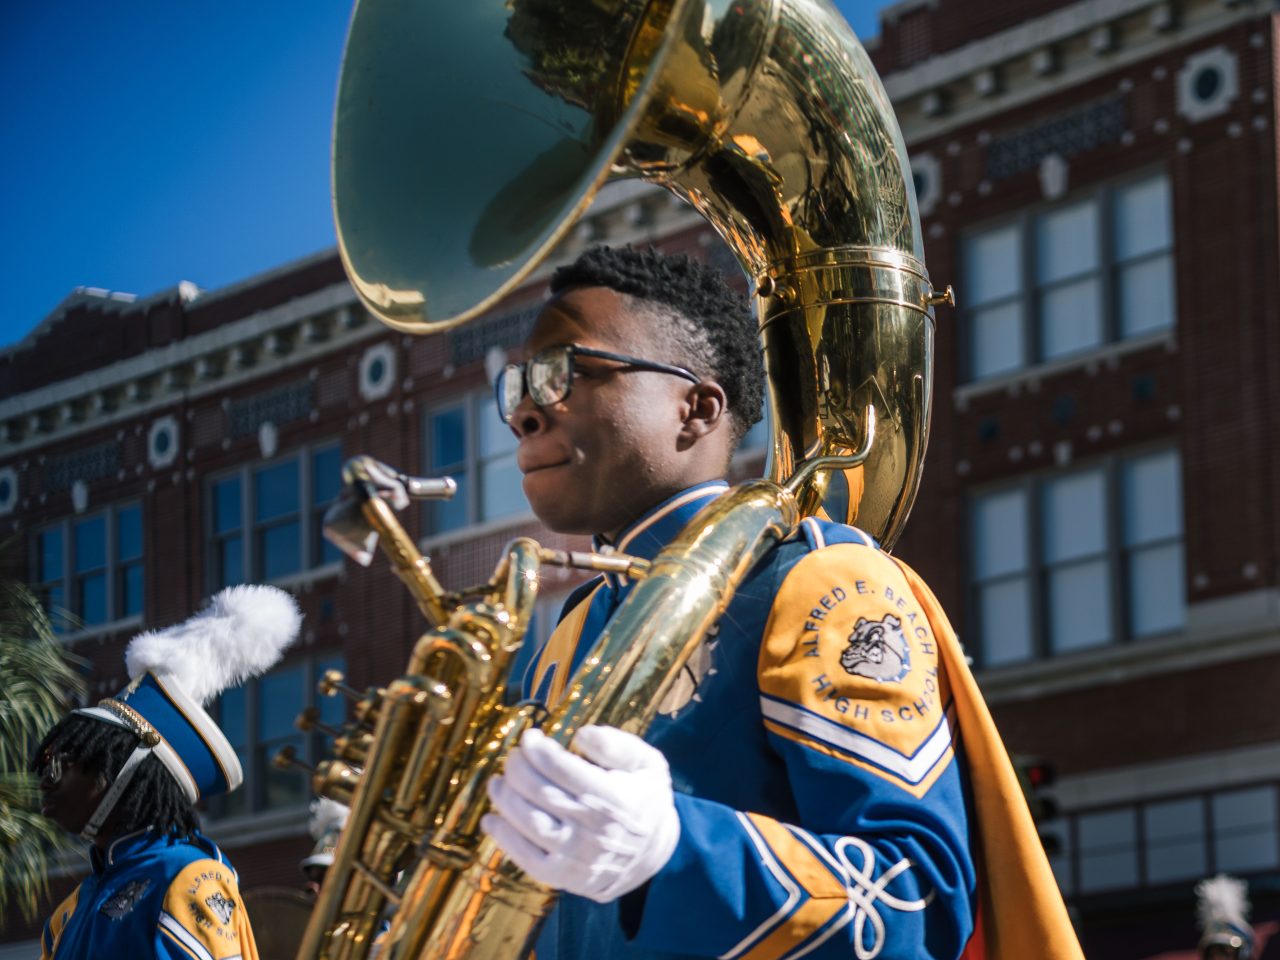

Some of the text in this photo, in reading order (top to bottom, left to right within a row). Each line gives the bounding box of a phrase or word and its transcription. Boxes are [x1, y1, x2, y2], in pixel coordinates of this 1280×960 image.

[803, 579, 935, 657] ALFRED E. BEACH
[812, 673, 869, 720] HIGH
